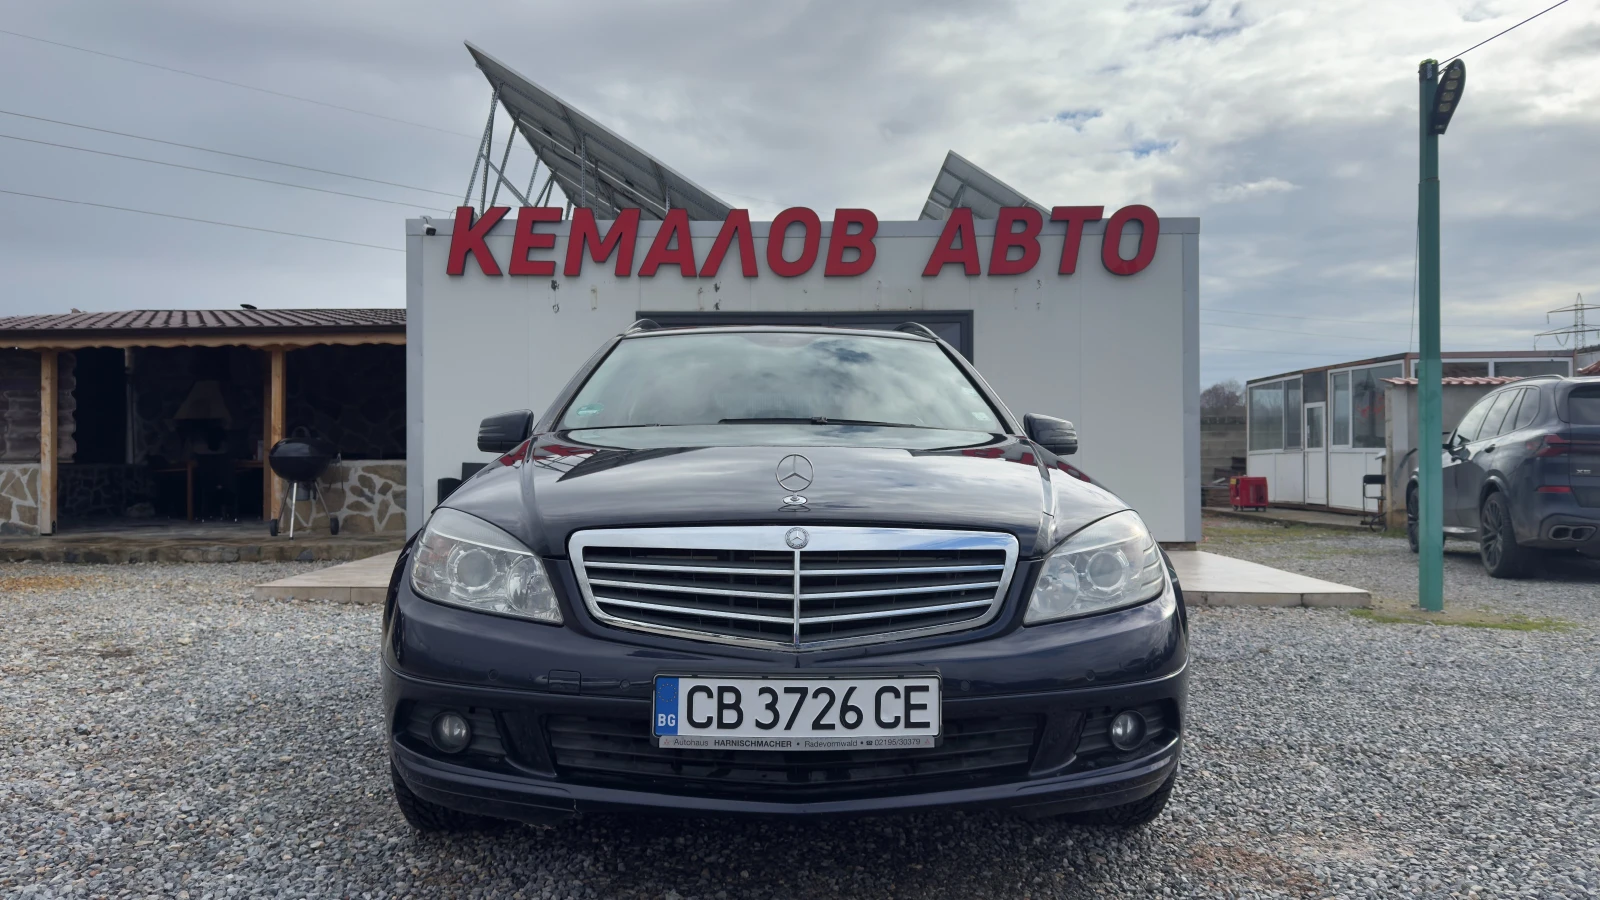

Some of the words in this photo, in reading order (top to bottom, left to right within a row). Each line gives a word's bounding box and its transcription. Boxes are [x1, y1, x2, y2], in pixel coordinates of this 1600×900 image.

[446, 205, 879, 277] КЕМАЛОВ
[921, 204, 1161, 277] АВТО
[657, 714, 676, 727] BG
[686, 685, 744, 729] CB
[755, 686, 864, 731] 3726
[874, 685, 931, 729] CE
[673, 738, 709, 746] Autohaus
[714, 739, 792, 748] HARNISCHMACHER
[804, 739, 858, 748] Radevormwald
[874, 738, 921, 746] 02195/30379
